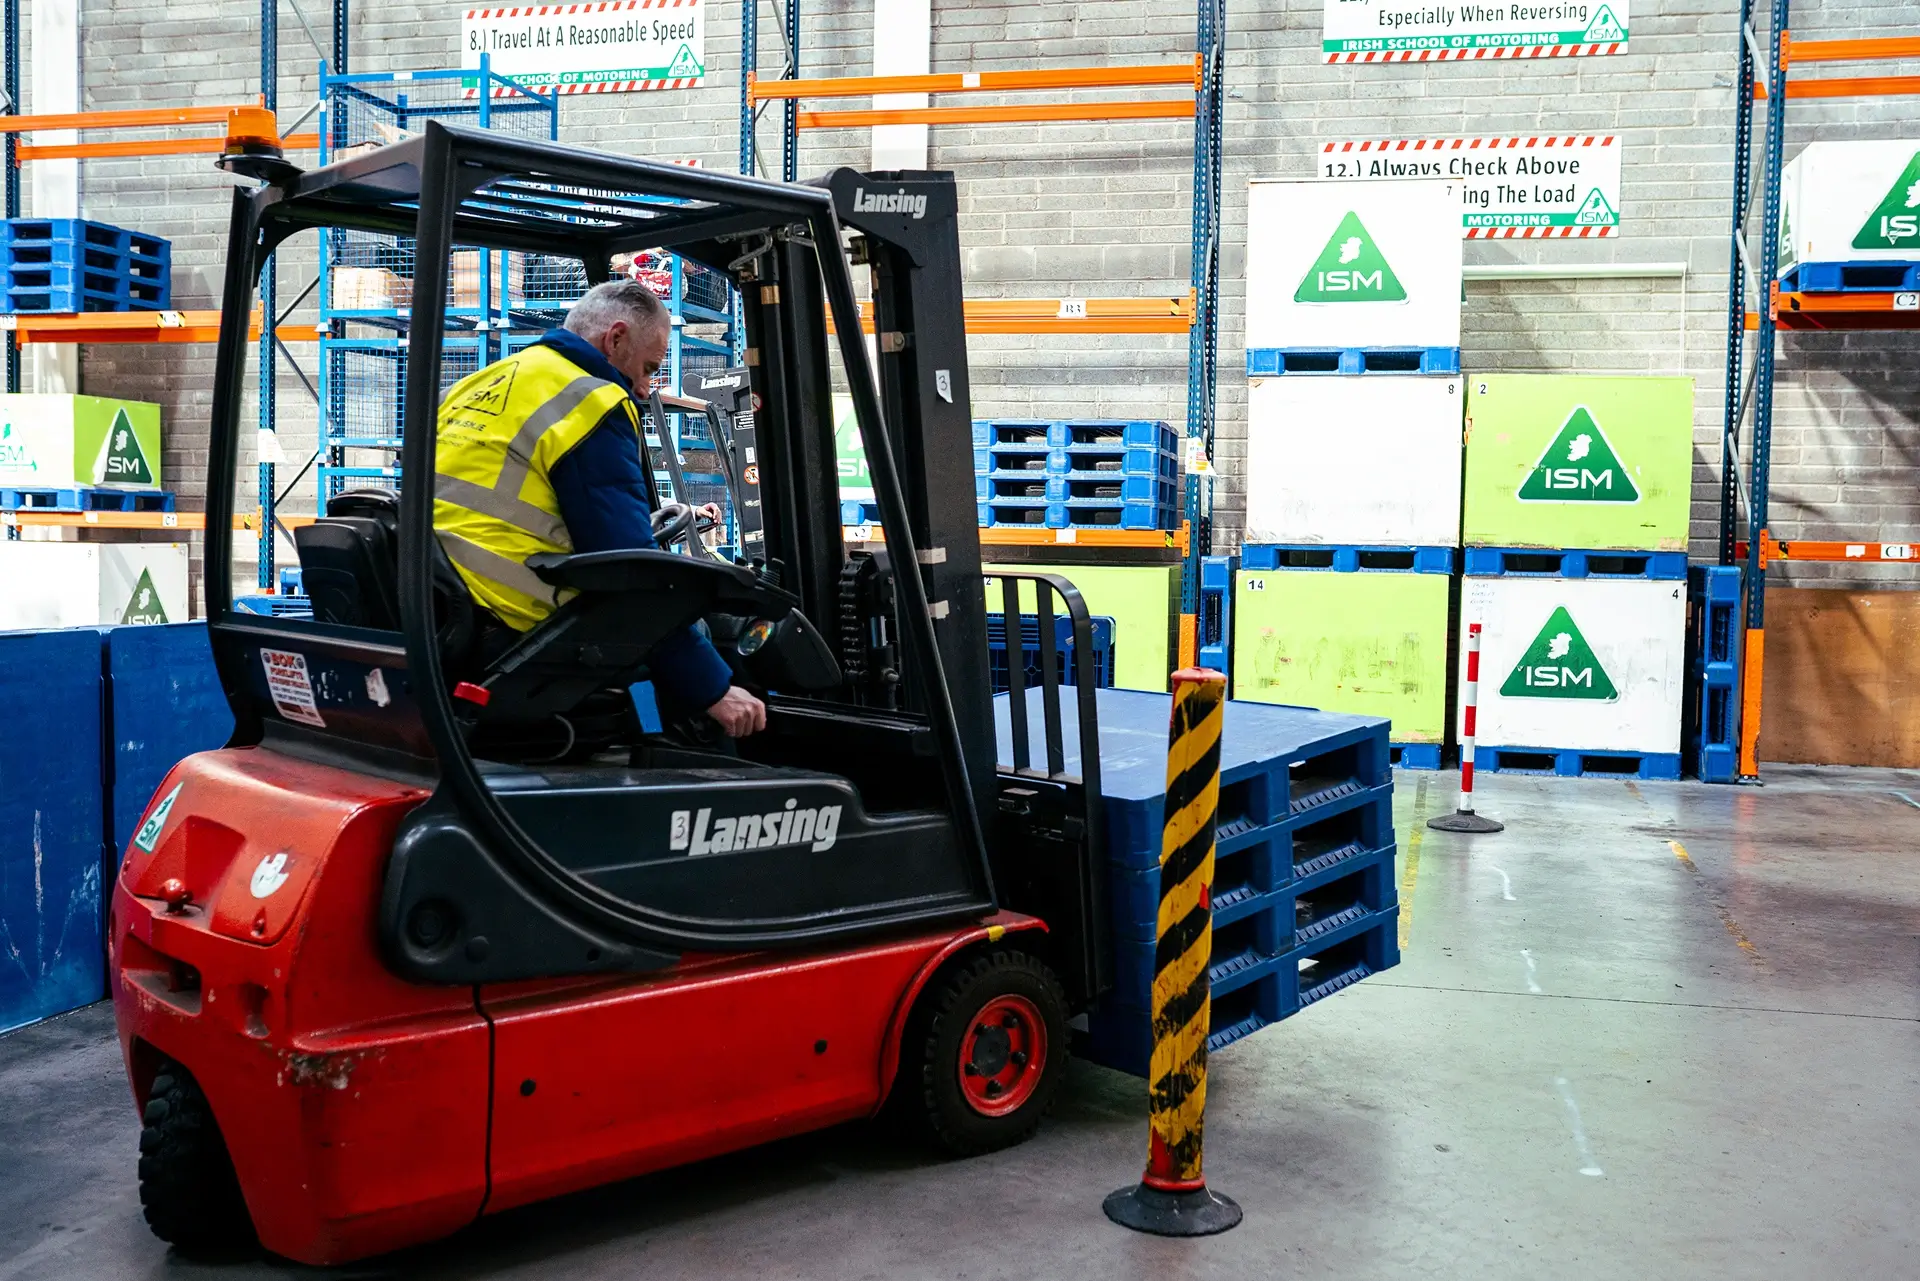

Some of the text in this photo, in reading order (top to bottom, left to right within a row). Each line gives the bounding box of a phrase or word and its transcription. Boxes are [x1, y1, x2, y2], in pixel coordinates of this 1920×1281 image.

[1379, 3, 1588, 29] Especially When Reversing
[470, 17, 695, 52] 8.) Travel At A Reasonable Speed
[1342, 33, 1559, 51] IRISH SCHOOL OF MOTORING
[1589, 28, 1619, 40] ISM
[563, 72, 579, 84] OF
[582, 69, 649, 81] MOTORING
[673, 65, 697, 76] ISM
[1325, 158, 1362, 178] 12.)
[1449, 156, 1508, 176] Check
[1515, 156, 1581, 175] Above
[1446, 186, 1452, 196] 7
[1463, 183, 1576, 208] ing The Load
[853, 187, 928, 219] Lansing
[1467, 214, 1550, 226] MOTORING
[1581, 211, 1609, 223] ISM
[1880, 215, 1920, 239] IS
[1318, 270, 1383, 292] ISM
[1896, 293, 1917, 307] C2
[701, 374, 741, 390] Lansing
[939, 375, 948, 391] 3
[1448, 384, 1455, 395] 8
[1480, 384, 1487, 395] 2
[466, 390, 500, 405] SM
[1545, 468, 1613, 490] ISM
[1885, 546, 1903, 558] C1
[1248, 579, 1264, 590] 14
[1672, 589, 1679, 600] 4
[1525, 666, 1592, 688] ISM
[674, 816, 685, 840] 3
[688, 797, 843, 857] Lansing
